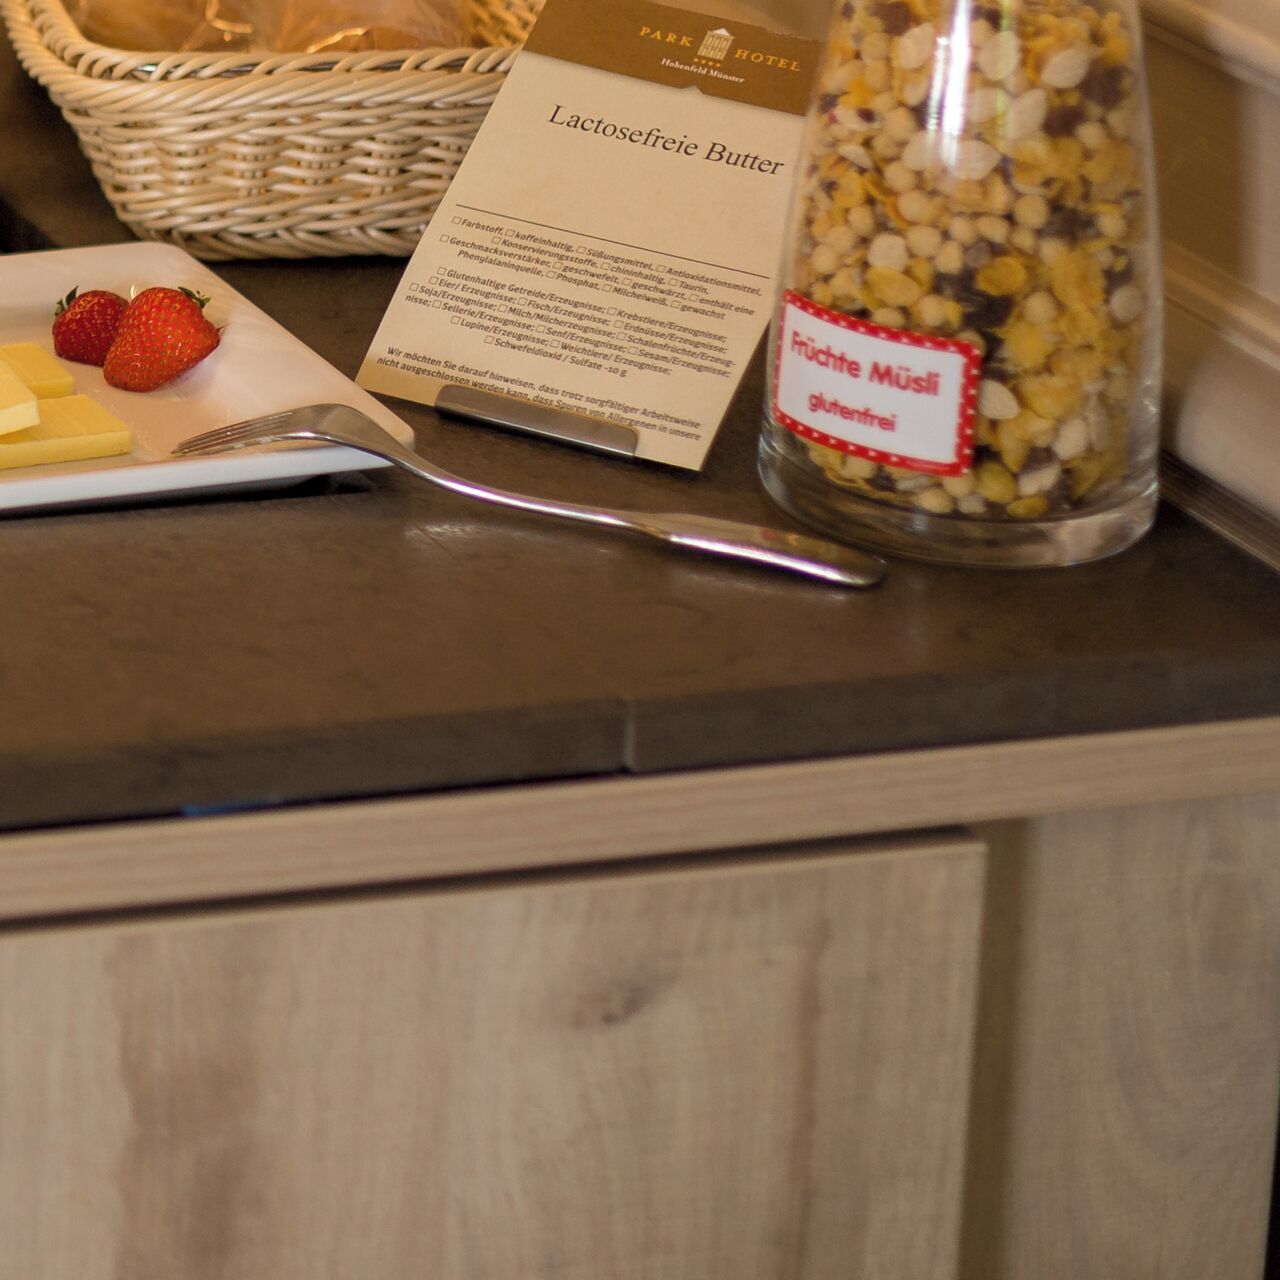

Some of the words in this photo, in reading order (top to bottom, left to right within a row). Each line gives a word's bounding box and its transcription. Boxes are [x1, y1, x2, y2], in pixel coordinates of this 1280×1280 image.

[640, 26, 692, 46] PARK
[735, 49, 798, 71] HOTEL
[661, 58, 707, 74] Hohenfeld
[710, 69, 744, 82] Münster
[549, 104, 698, 156] Lactosefreie
[704, 142, 784, 174] Butter
[449, 237, 551, 268] Geschmacksverstärker,
[561, 265, 619, 284] geschwefelt,
[630, 281, 687, 300] geschwärzt,
[698, 298, 734, 310] enthält
[734, 306, 755, 315] eine
[457, 249, 543, 277] Phenylalaninquelle,
[555, 272, 600, 290] Phosphat,
[611, 286, 668, 307] Milcheiweiß,
[679, 304, 726, 320] gewachst
[460, 218, 504, 235] Farbstoff,
[514, 231, 574, 252] koffeinhaltig,
[585, 248, 653, 271] Süßungsmittel,
[665, 267, 761, 296] Antioxidationsmittel,
[500, 238, 598, 268] Konservierungsstoffe,
[609, 265, 665, 285] chininhaltig,
[679, 280, 709, 295] Taurin,
[405, 294, 431, 307] nisse;
[441, 302, 535, 332] Sellerie/Erzeugnisse;
[544, 326, 627, 353] Senf/Erzeugnisse;
[637, 348, 731, 377] Sesam/Erzeugnisse;
[418, 285, 497, 311] Soja/Erzeugnisse;
[507, 306, 616, 339] Milch/Milcherzeugnisse;
[626, 334, 736, 368] Schalenfrüchte/Erzeug-
[438, 278, 460, 290] Eier/
[460, 283, 517, 304] Erzeugnisse;
[526, 299, 611, 326] Fisch/Erzeugnisse;
[623, 322, 728, 354] Erdnüsse/Erzeugnisse;
[446, 269, 506, 290] Glutenhaltige
[507, 283, 606, 314] Getreide/Erzeugnisse;
[616, 309, 727, 343] Krebstiere/Erzeugnisse;
[460, 318, 549, 346] Lupine/Erzeugnisse;
[560, 341, 613, 361] Weichtiere/
[613, 354, 672, 375] Erzeugnisse;
[493, 337, 562, 360] Schwefeldioxid
[568, 355, 602, 370] Sulfate
[619, 369, 627, 377] g
[791, 330, 861, 378] Früchte
[869, 361, 942, 396] Müsli
[376, 357, 400, 368] nicht
[400, 363, 469, 384] ausgeschlossen
[471, 380, 504, 393] werden
[505, 386, 530, 401] kann,
[532, 394, 553, 406] dass
[554, 399, 587, 413] Spuren
[606, 412, 657, 430] Allergenen
[657, 423, 668, 433] in
[668, 428, 701, 440] unsere
[387, 346, 402, 356] Wir
[402, 352, 441, 366] möchten
[442, 360, 457, 370] Sie
[457, 364, 490, 377] darauf
[488, 371, 535, 390] hinweisen,
[538, 384, 559, 395] dass
[560, 389, 584, 401] trotz
[584, 396, 640, 414] sorgfältiger
[640, 408, 701, 429] Arbeitsweise
[808, 391, 897, 433] glutenfrei
